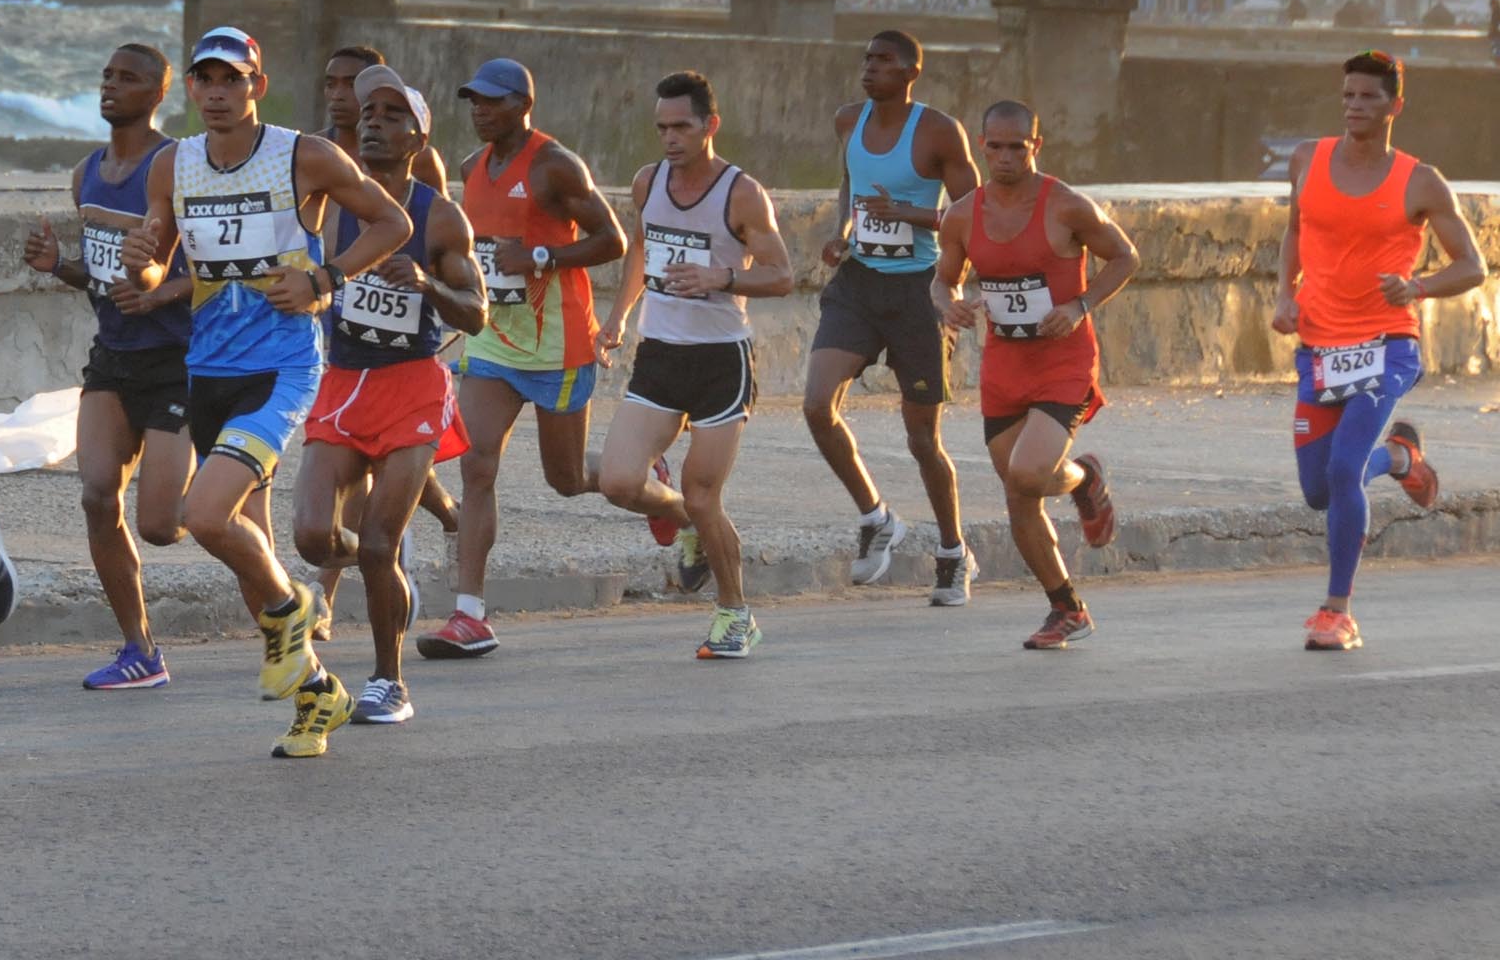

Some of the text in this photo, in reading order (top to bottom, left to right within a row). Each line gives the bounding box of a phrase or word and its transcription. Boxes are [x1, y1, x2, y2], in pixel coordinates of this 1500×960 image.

[187, 204, 213, 217] XXX
[218, 218, 243, 246] 27
[352, 286, 409, 318] 2055
[1004, 293, 1028, 313] 29
[1331, 350, 1375, 374] 4520
